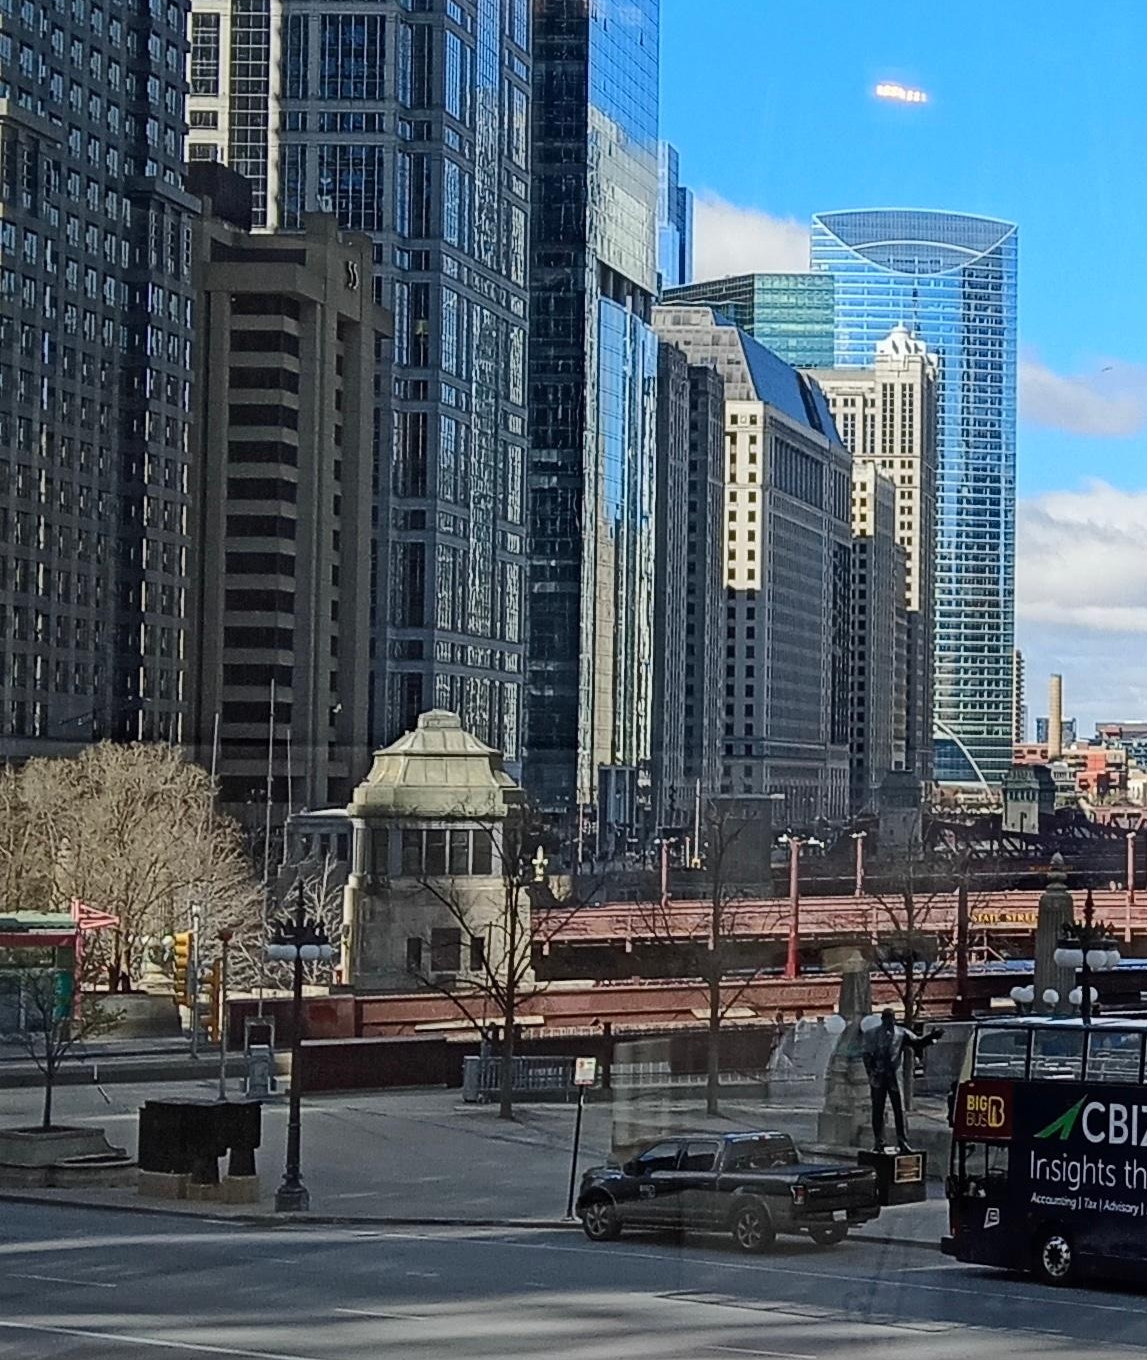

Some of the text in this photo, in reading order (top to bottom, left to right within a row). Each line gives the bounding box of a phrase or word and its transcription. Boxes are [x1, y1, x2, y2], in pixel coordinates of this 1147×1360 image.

[972, 912, 999, 923] STATE
[966, 1094, 988, 1111] BIG
[966, 1112, 988, 1128] BUS
[1030, 1150, 1117, 1191] Insights
[1030, 1192, 1077, 1210] Accounting
[1084, 1197, 1098, 1210] Tax
[1103, 1200, 1139, 1217] Advisory
